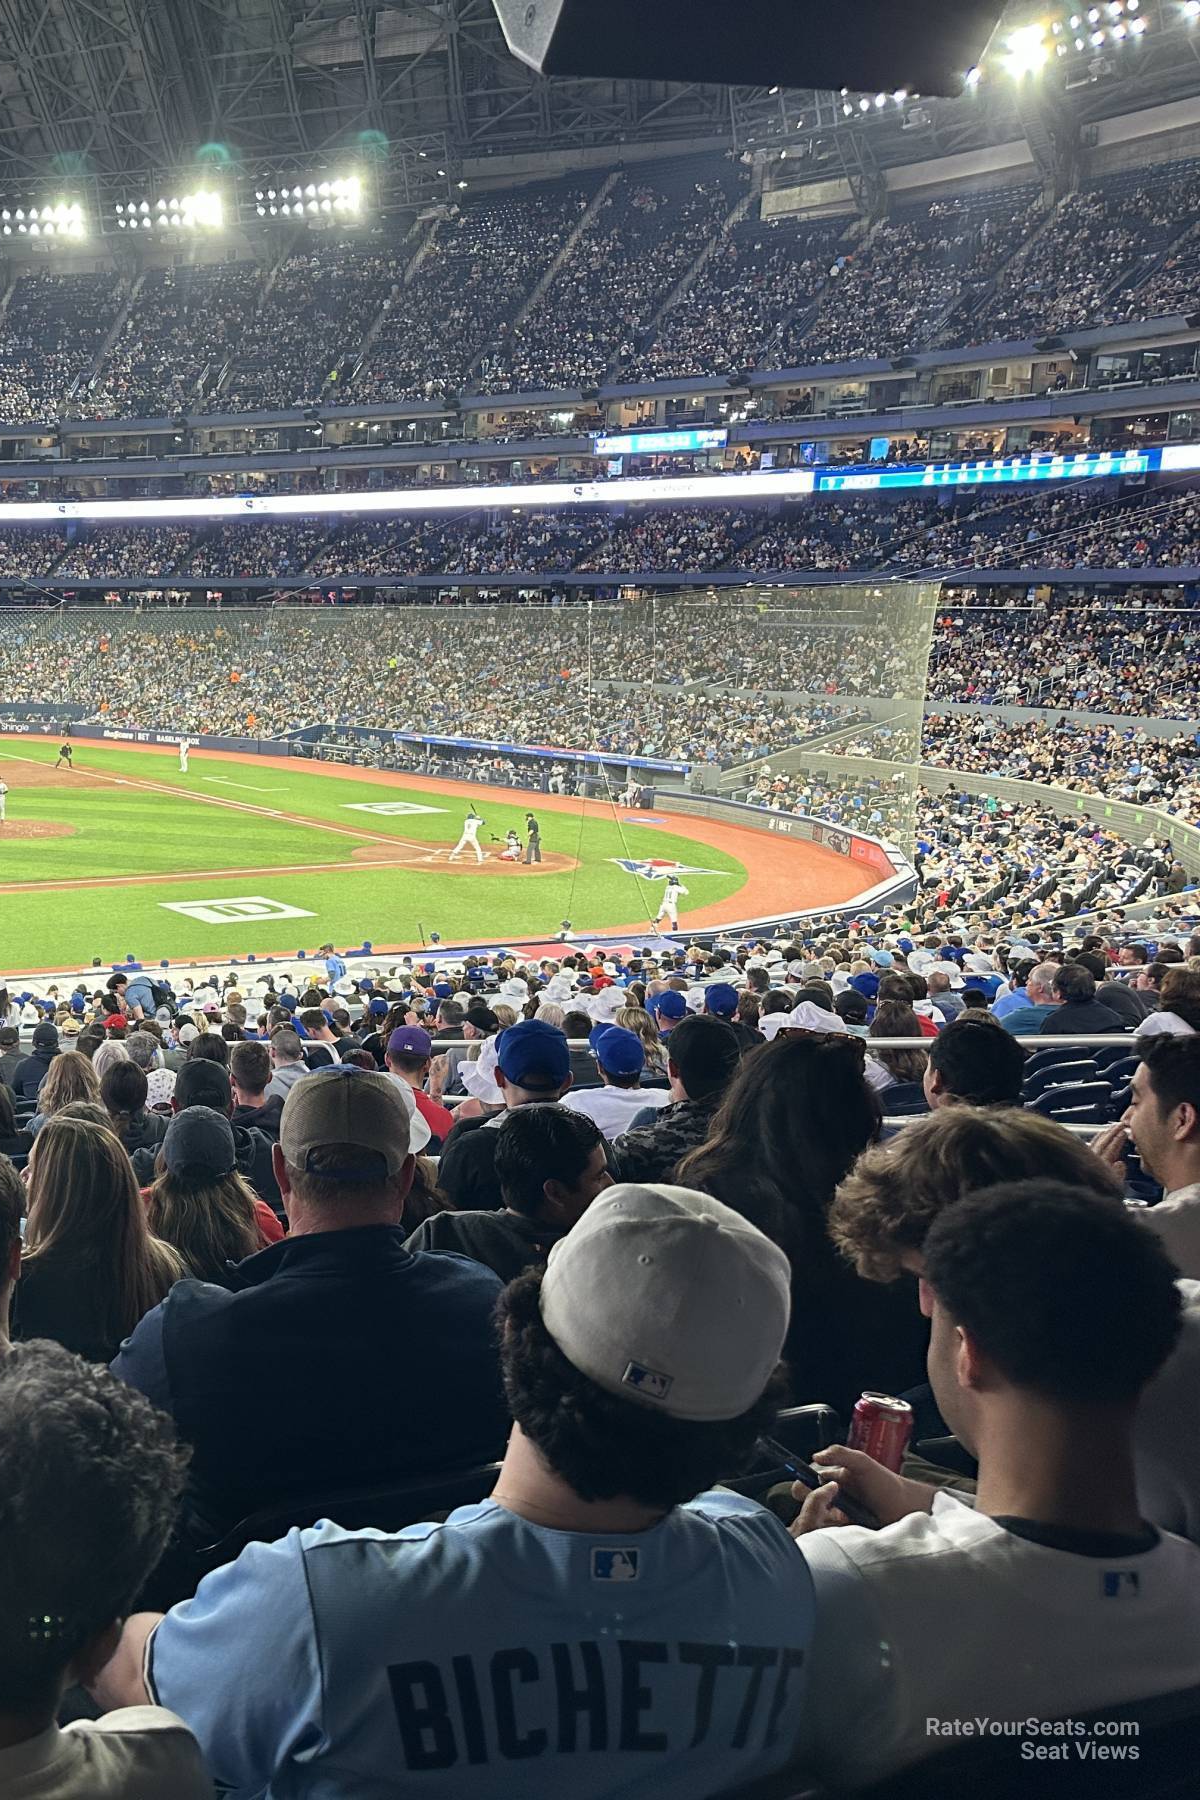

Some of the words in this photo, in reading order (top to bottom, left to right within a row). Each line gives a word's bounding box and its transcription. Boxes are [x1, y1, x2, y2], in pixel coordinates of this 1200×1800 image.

[1, 722, 29, 733] Shingle
[137, 732, 150, 741] BET
[156, 734, 183, 744] BASELIN
[778, 820, 793, 832] BET
[178, 901, 288, 917] TD
